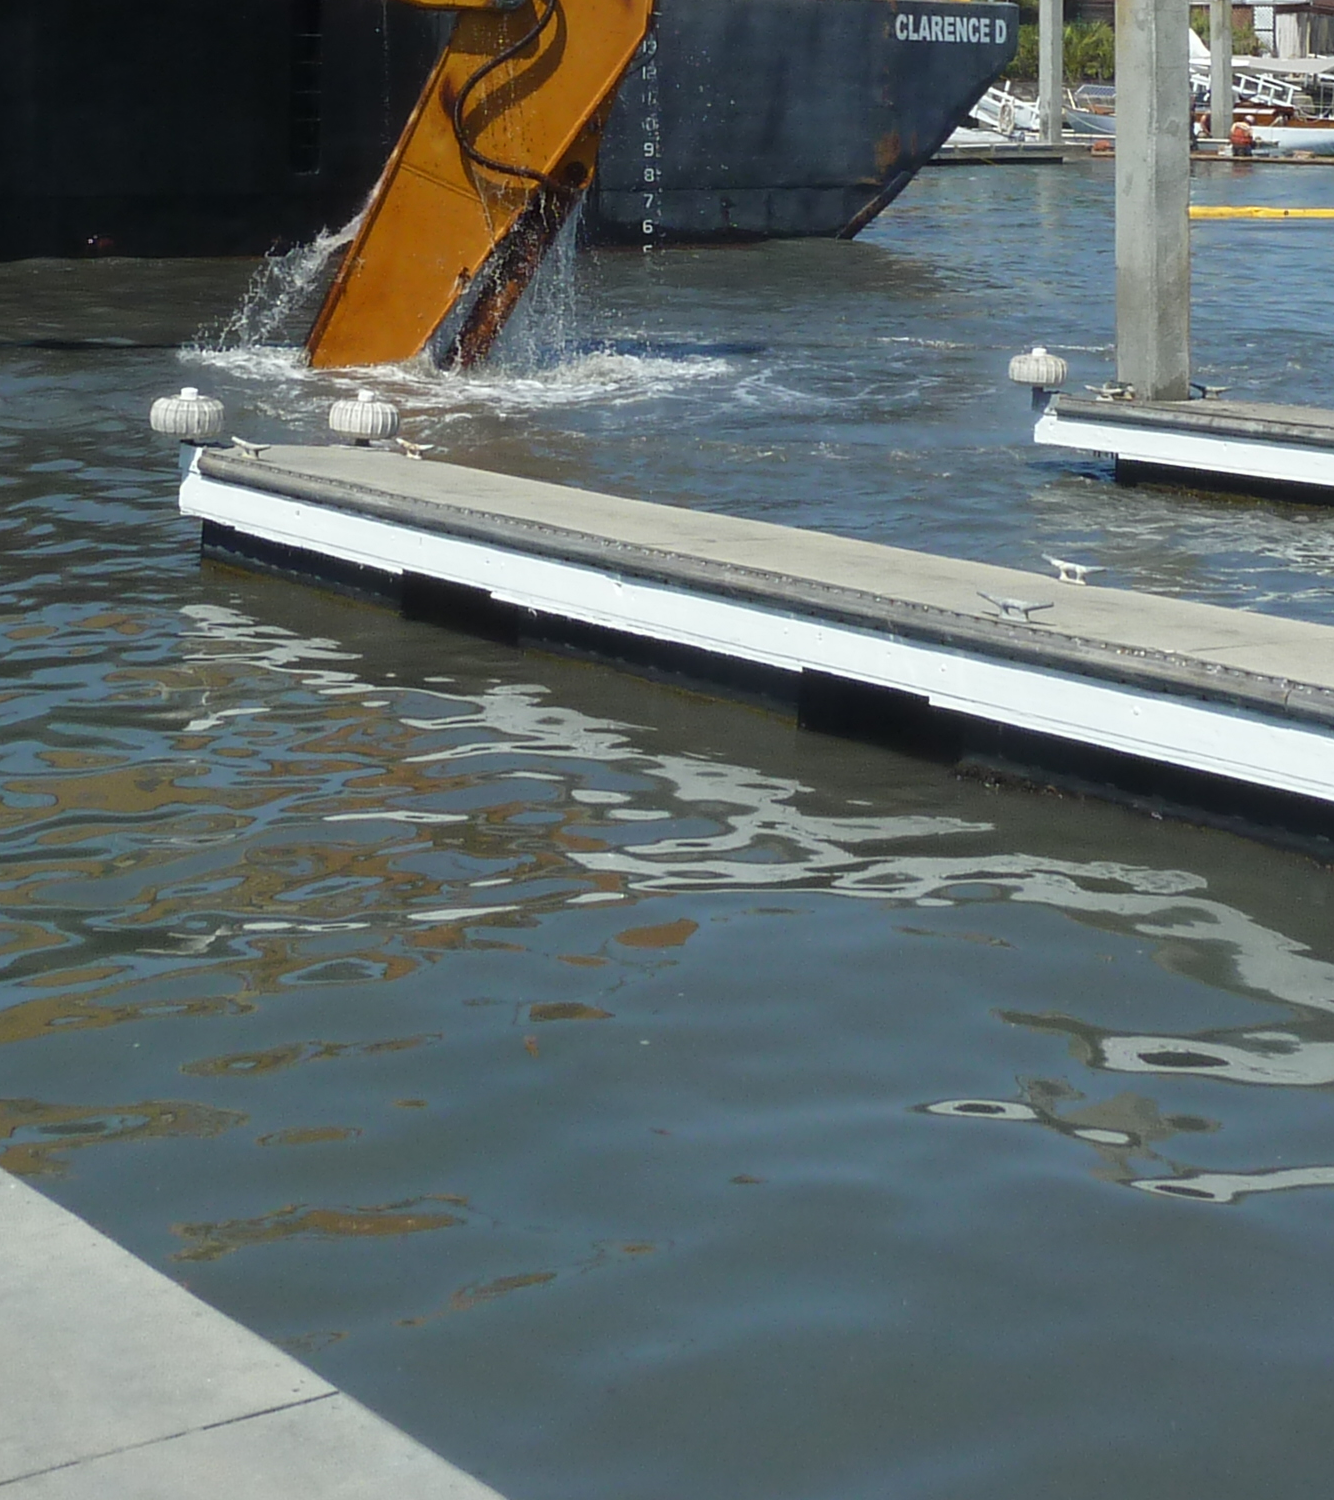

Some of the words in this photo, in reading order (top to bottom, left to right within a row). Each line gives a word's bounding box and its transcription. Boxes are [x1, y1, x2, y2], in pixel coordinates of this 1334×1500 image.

[895, 13, 990, 43] CLARENCE
[995, 19, 1007, 44] D
[642, 66, 657, 80] 12
[643, 142, 655, 157] 9
[644, 168, 655, 182] 8
[643, 193, 654, 208] 7
[642, 220, 653, 234] 6
